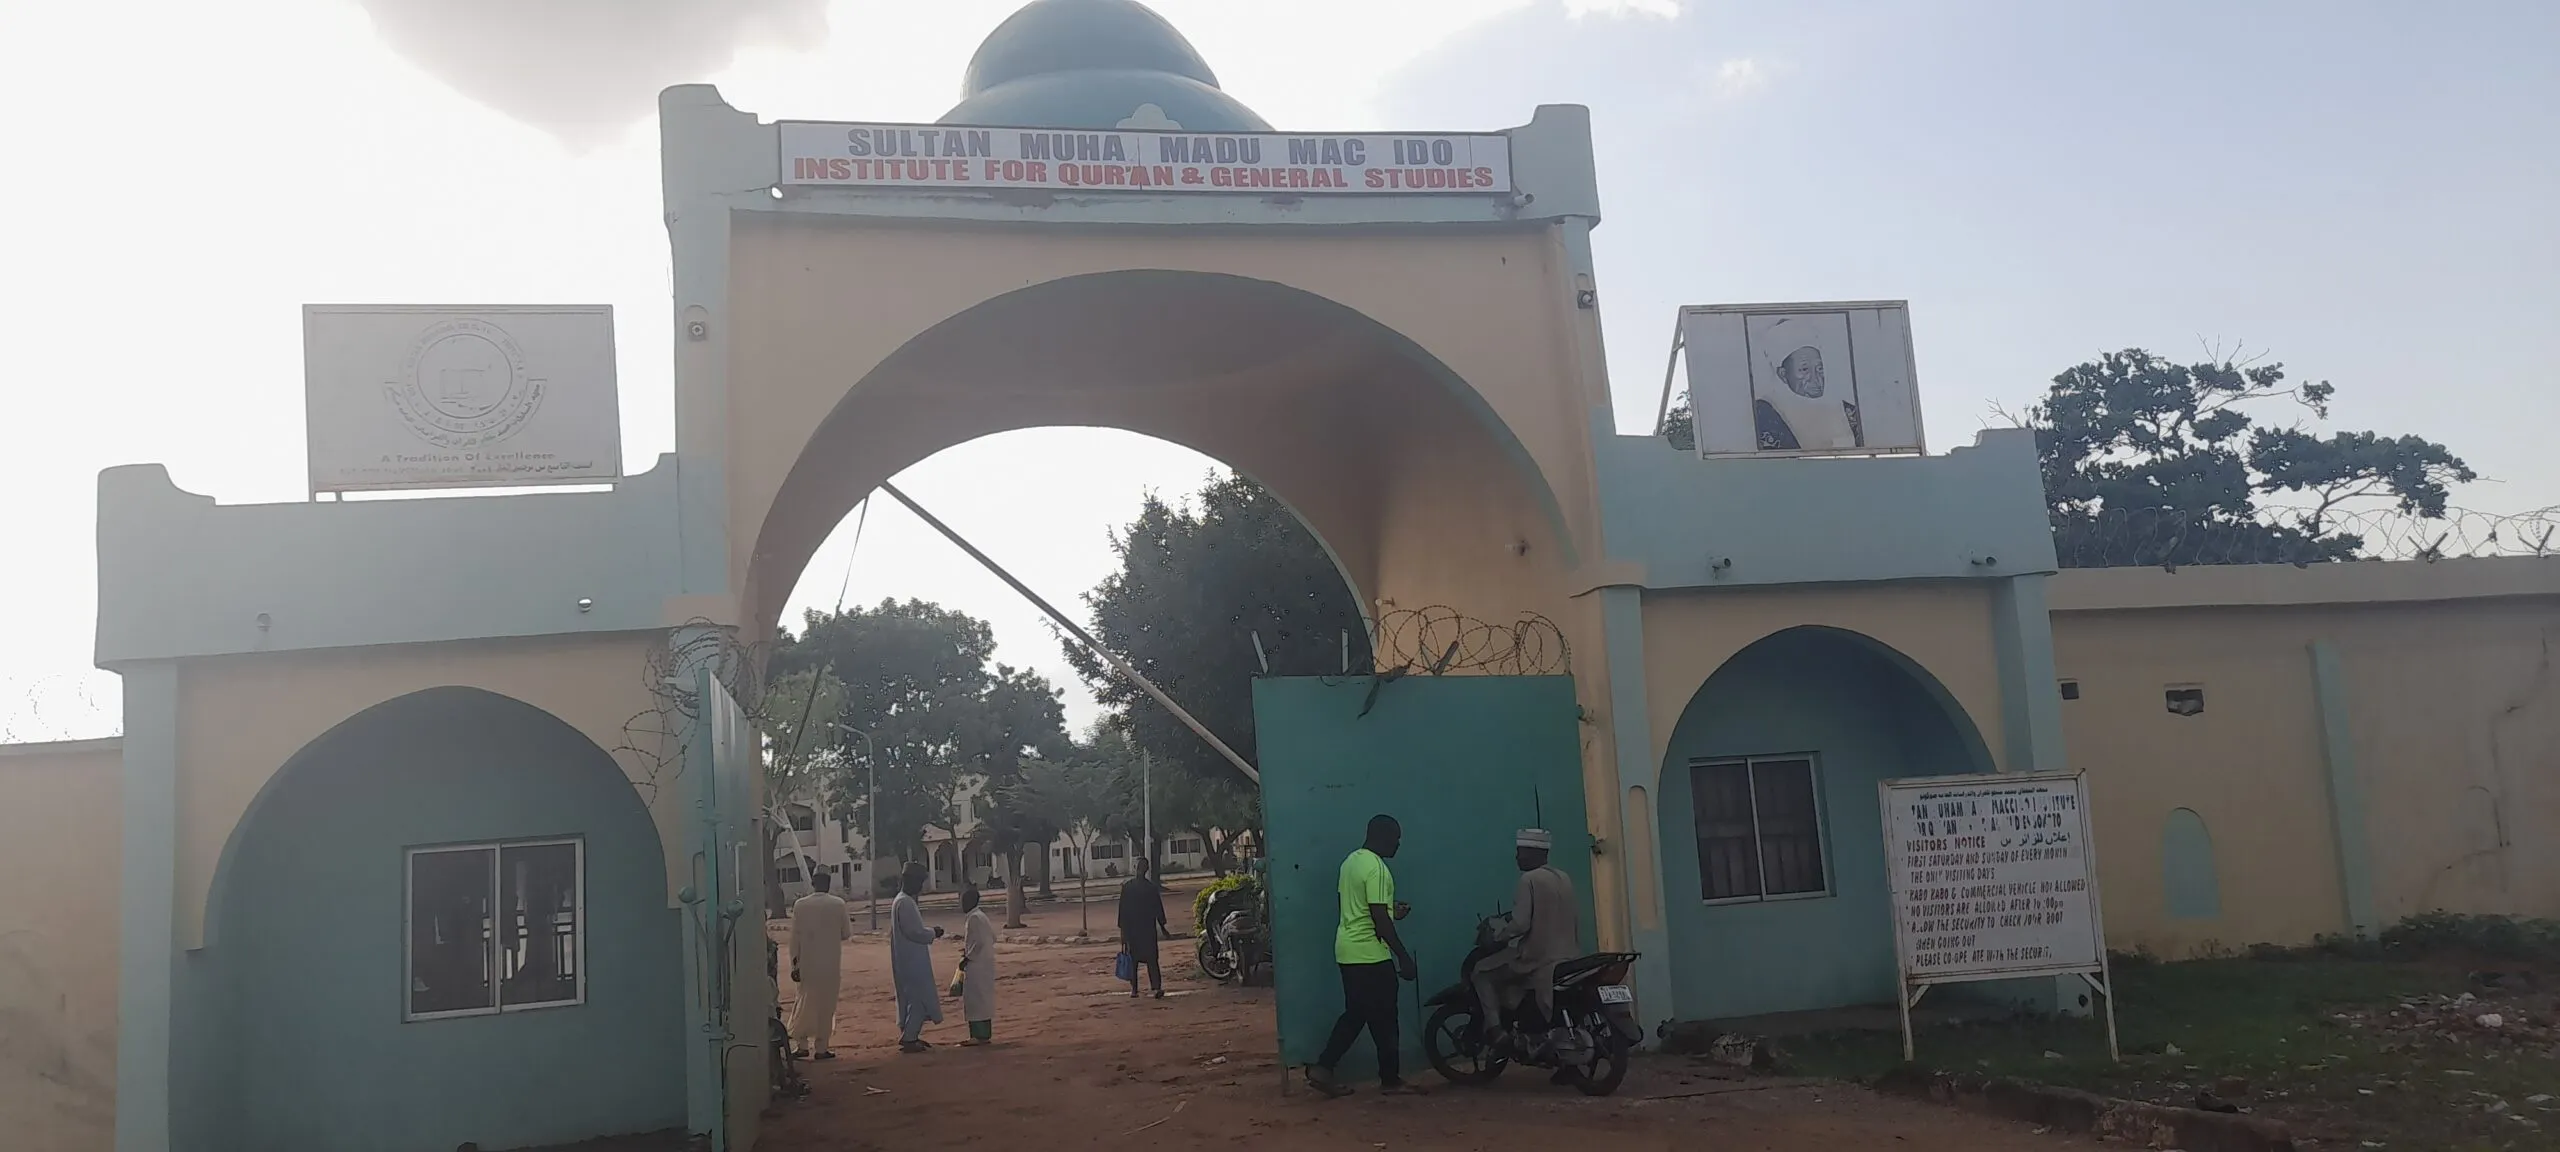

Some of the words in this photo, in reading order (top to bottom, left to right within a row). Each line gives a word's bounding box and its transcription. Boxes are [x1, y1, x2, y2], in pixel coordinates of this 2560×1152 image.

[848, 128, 992, 158] SULTAN
[794, 157, 969, 181] INSTITUTE
[984, 159, 1047, 183] FOR
[1058, 163, 1174, 187] QUR'AN
[1180, 166, 1205, 185] &
[1210, 166, 1349, 189] GENERAL
[1364, 167, 1494, 189] STUDIES
[396, 453, 460, 463] Tradition
[1907, 838, 1947, 852] VISITORS
[1955, 836, 1986, 849] NOTICE
[1907, 855, 1926, 868] FIRST
[1928, 852, 1964, 867] SATURDAY
[1966, 851, 1980, 864] AND
[2011, 850, 2019, 863] OF
[2021, 848, 2042, 861] EVERY
[1945, 867, 1975, 882] VISITING
[2009, 881, 2037, 896] VEHICLE
[2055, 878, 2086, 893] ALLOWED
[1911, 904, 1920, 917] NO
[1922, 903, 1955, 917] VISITORS
[1956, 902, 1970, 915] ARE
[2010, 898, 2031, 911] AFTER
[2000, 913, 2022, 928] CHECK
[1938, 935, 1960, 950] GOING
[1962, 934, 1976, 948] OUT
[1916, 951, 1941, 967] PLEASE
